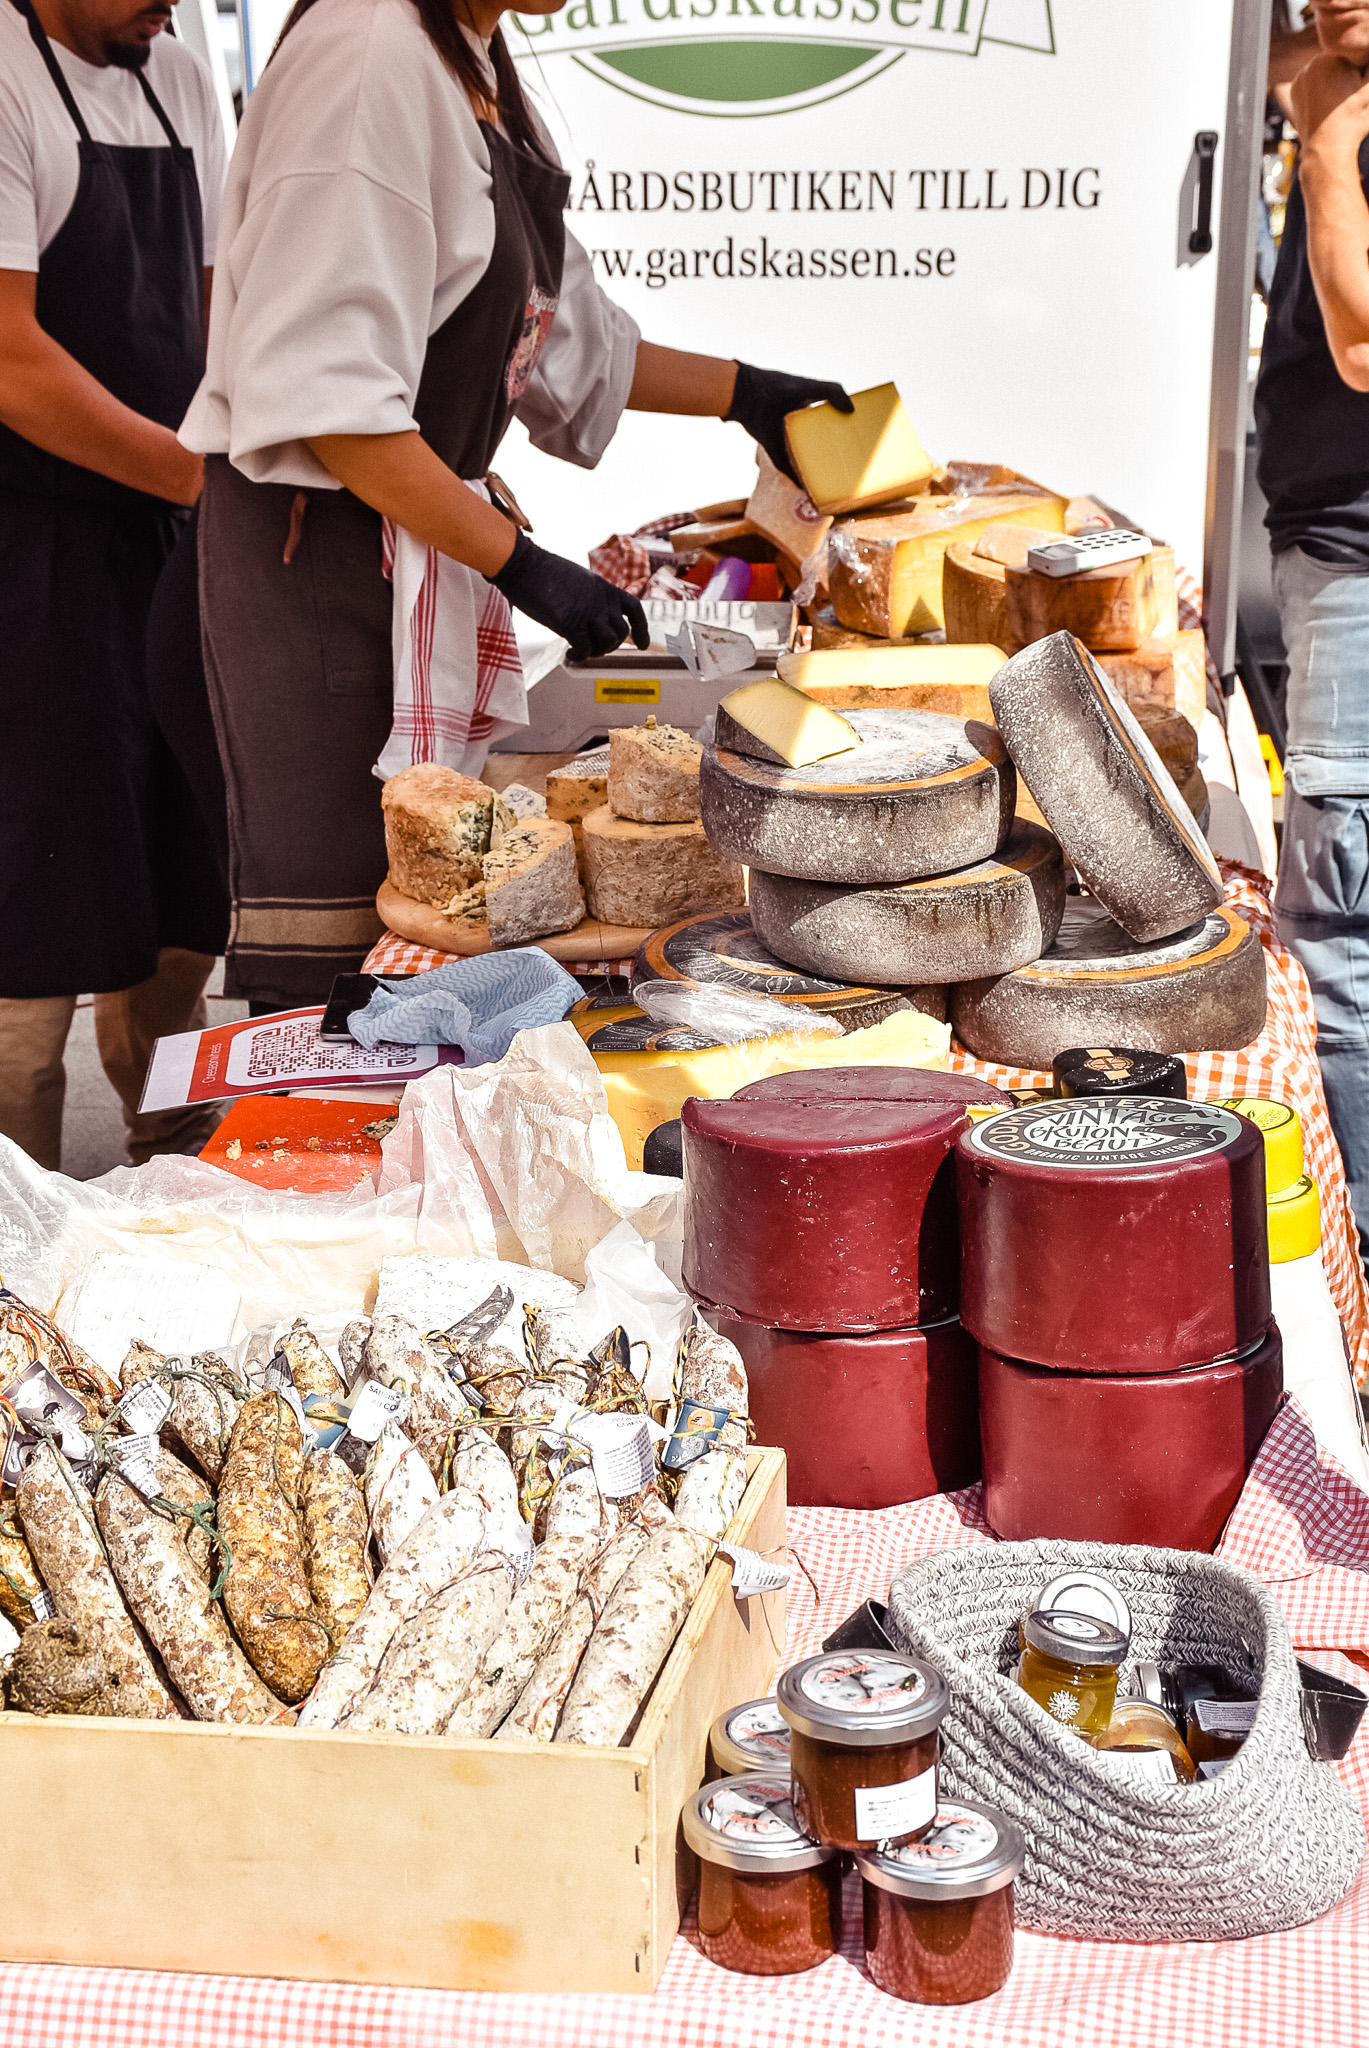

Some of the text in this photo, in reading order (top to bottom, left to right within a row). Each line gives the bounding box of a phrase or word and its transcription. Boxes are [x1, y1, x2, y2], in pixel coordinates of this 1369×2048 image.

[564, 159, 1103, 212] ÅRDSBUTIKEN TILL DIG
[1049, 1107, 1187, 1125] VINTAGE
[1029, 1125, 1131, 1140] BRUTON
[1053, 1136, 1165, 1151] BEAUTY
[1023, 1147, 1080, 1161] ORGANIC
[1086, 1151, 1147, 1162] VINTAGE
